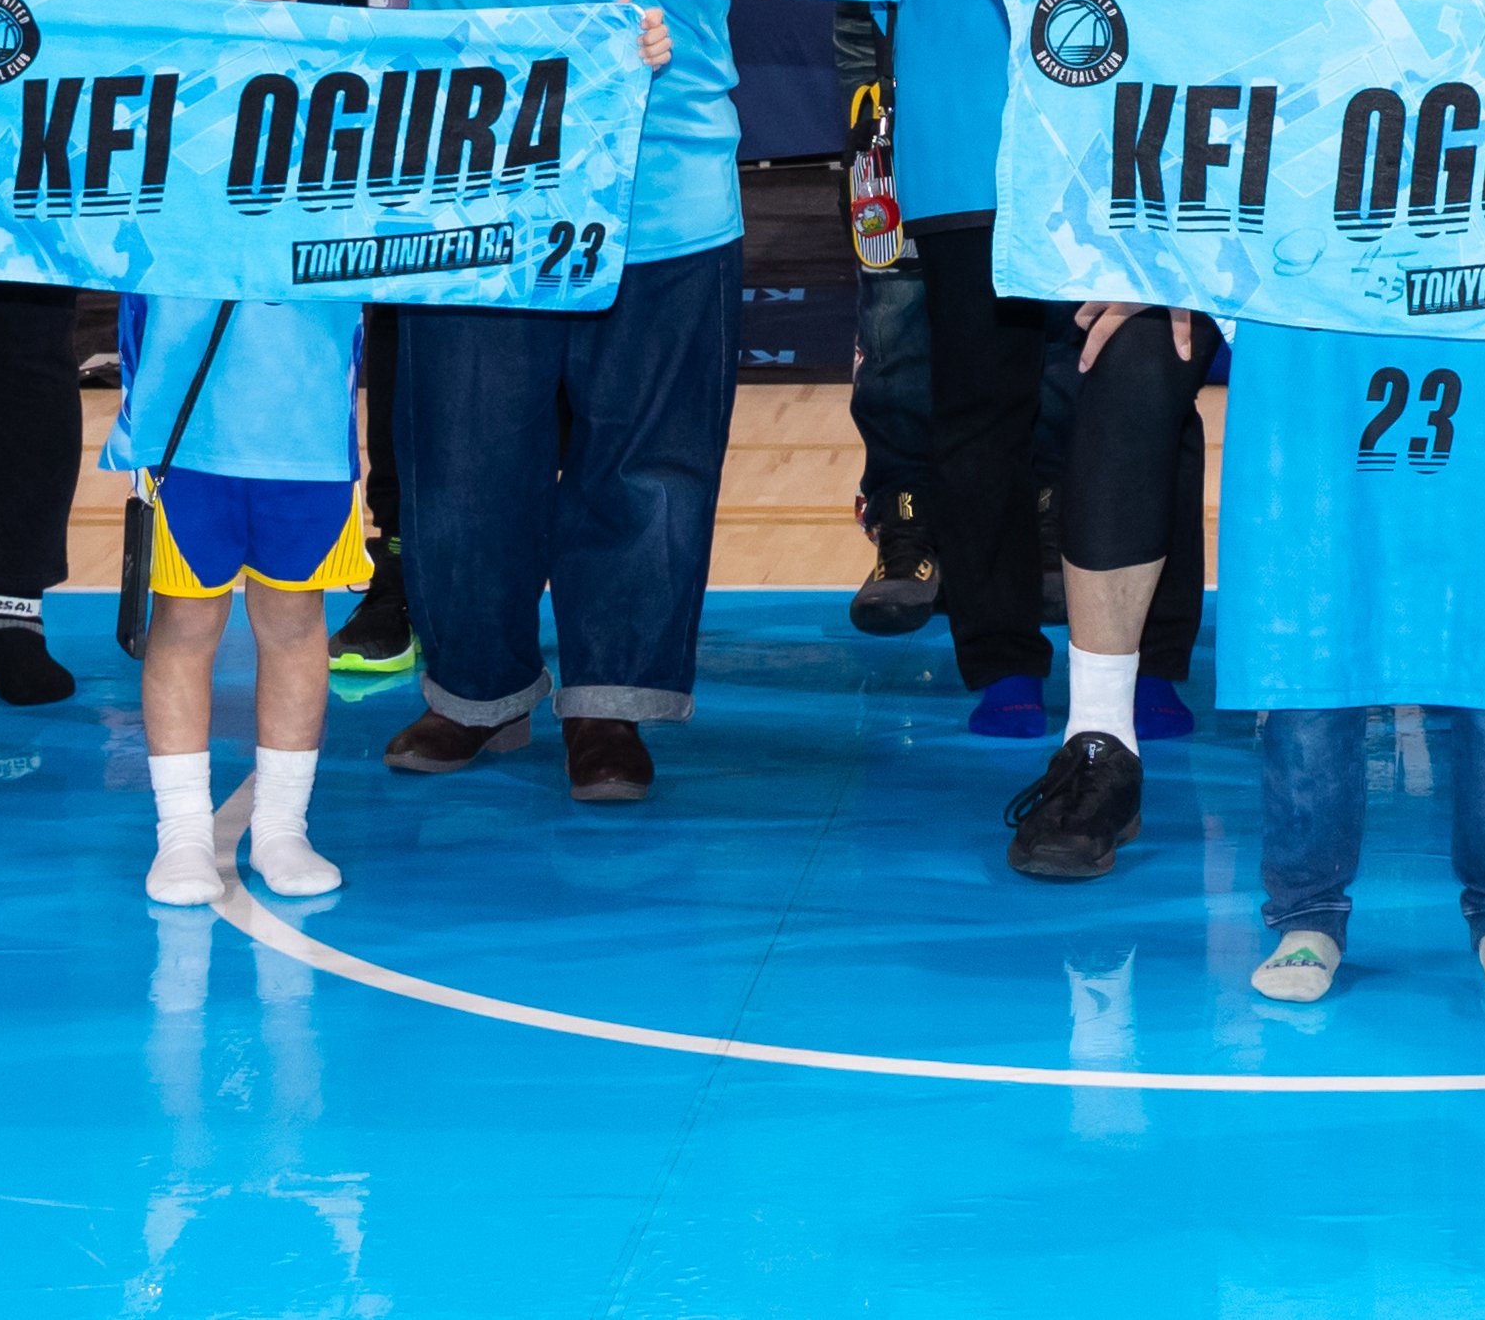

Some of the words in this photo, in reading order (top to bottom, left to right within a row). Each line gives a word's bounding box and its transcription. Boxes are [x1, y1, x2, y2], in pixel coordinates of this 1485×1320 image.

[8, 52, 32, 78] CLUB
[1035, 49, 1098, 84] BASKETBALL
[1098, 51, 1124, 78] CLUB
[226, 56, 569, 217] OGURA
[295, 240, 379, 281] TOKYO
[380, 229, 472, 273] UNITED
[474, 223, 514, 262] BC
[534, 220, 607, 288] 23
[1355, 365, 1462, 475] 23
